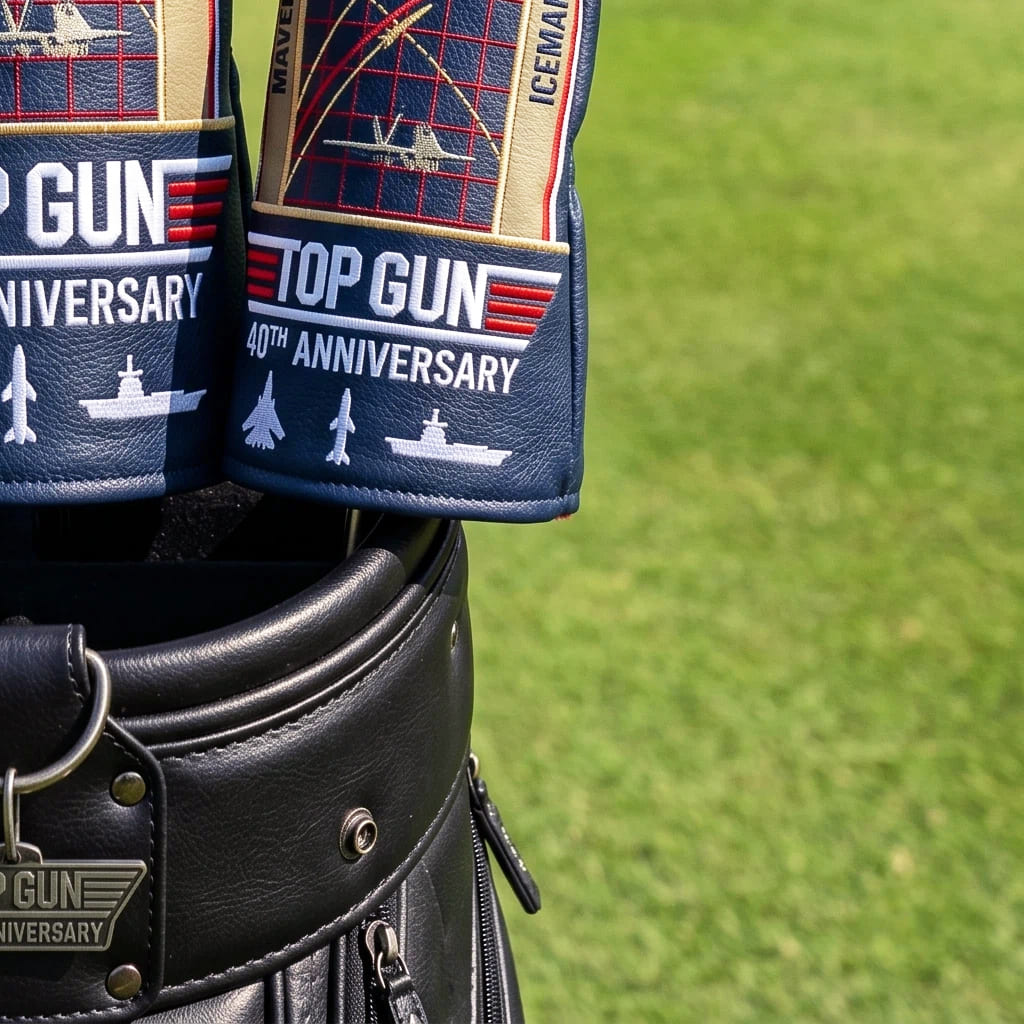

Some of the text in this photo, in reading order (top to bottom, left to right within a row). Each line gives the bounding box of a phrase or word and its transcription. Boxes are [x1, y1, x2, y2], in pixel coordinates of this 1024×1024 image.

[26, 160, 166, 248] GUN
[272, 240, 489, 330] TOP GUN
[246, 321, 521, 395] 40TH ANNIVERSARY
[13, 870, 82, 910] GUN
